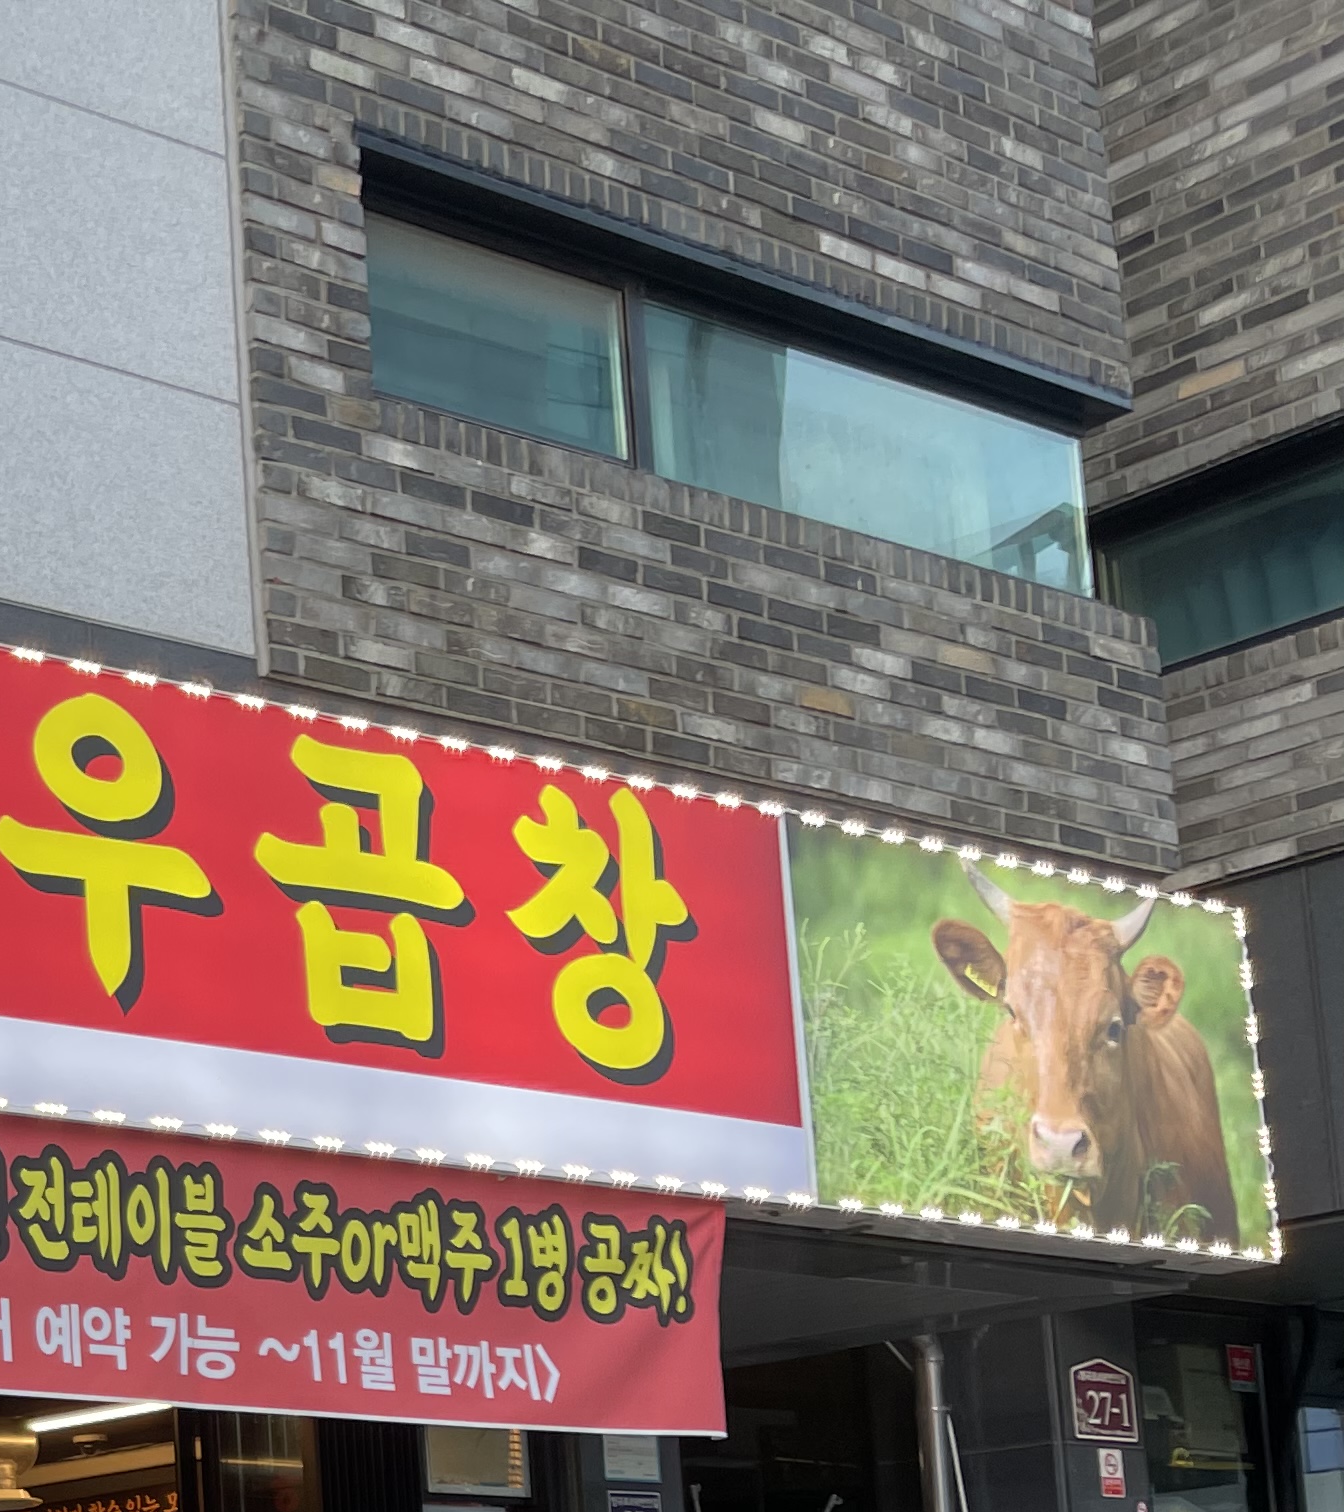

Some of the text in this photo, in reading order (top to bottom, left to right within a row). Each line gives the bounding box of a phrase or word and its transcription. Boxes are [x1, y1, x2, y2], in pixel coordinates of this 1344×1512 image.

[16, 1154, 228, 1281] 전테이블
[239, 1188, 495, 1306] 소주or맥주
[499, 1209, 568, 1315] 1병
[580, 1219, 691, 1320] 공짜!
[35, 1304, 130, 1370] 예약
[150, 1313, 239, 1380] 가능
[259, 1329, 394, 1391] ~11월
[1086, 1389, 1131, 1427] 27-1
